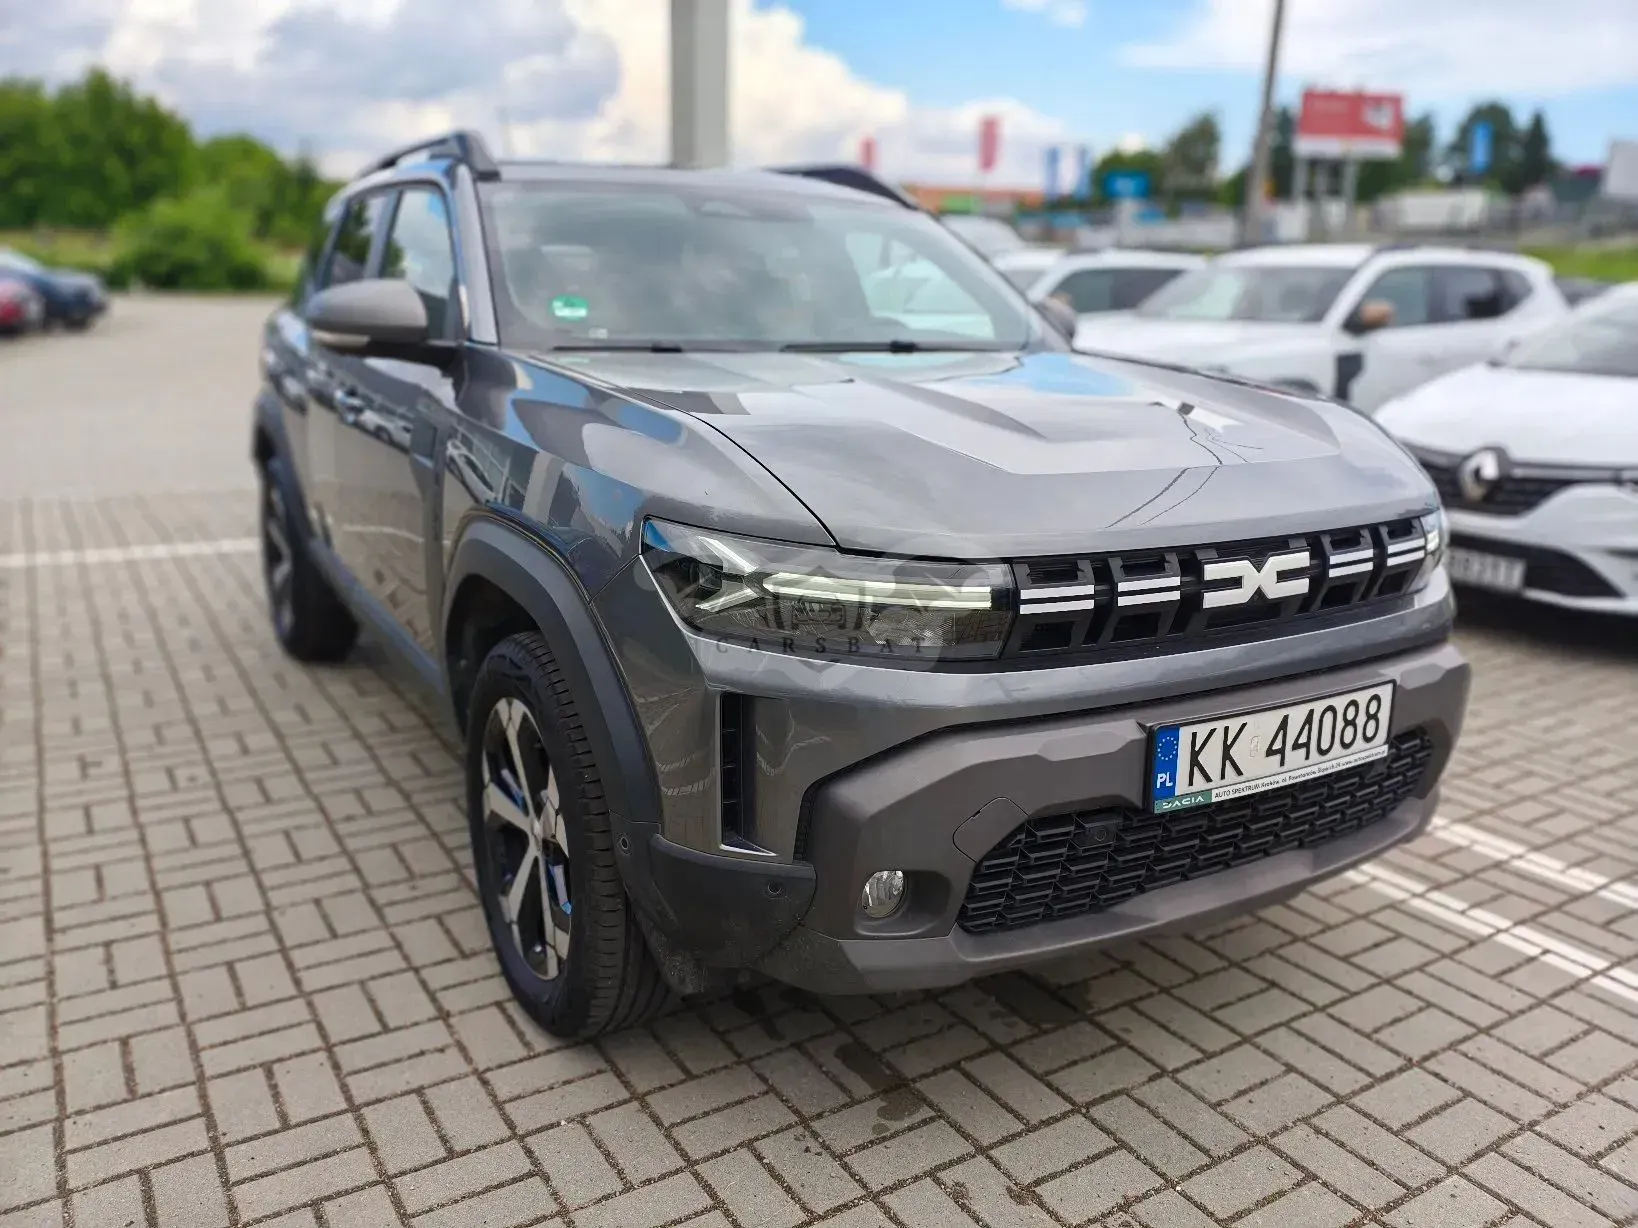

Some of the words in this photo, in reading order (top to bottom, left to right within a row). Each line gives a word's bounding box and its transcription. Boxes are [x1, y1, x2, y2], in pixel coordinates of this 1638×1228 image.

[1187, 722, 1248, 787] KK
[1265, 693, 1382, 768] 44088
[1156, 772, 1174, 789] PL
[1214, 789, 1231, 799] AUTO
[1231, 780, 1261, 795] SPEKTRUM
[1162, 795, 1205, 809] DACIA
